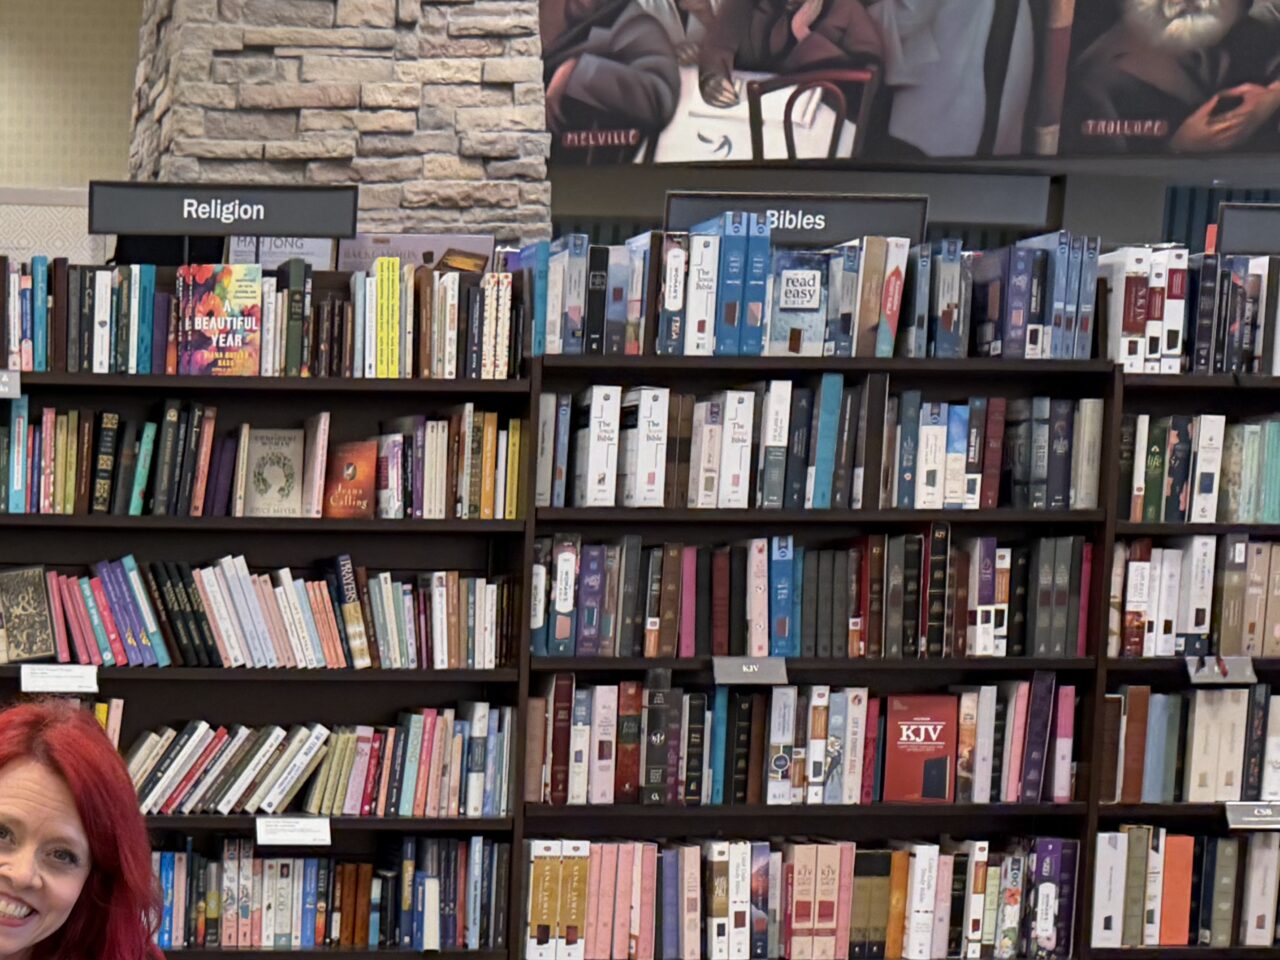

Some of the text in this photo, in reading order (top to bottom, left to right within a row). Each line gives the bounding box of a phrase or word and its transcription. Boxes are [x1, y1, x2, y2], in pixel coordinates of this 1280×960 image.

[565, 129, 639, 147] MELVILLE
[183, 199, 265, 223] Religion
[767, 210, 826, 230] Bibles
[268, 236, 304, 250] JONG
[785, 274, 816, 288] read
[784, 289, 816, 302] easy
[224, 299, 231, 312] A
[194, 317, 259, 330] BEAUTIFUL
[211, 334, 243, 347] YEAR
[337, 484, 363, 495] Jesus
[330, 494, 368, 510] Calling
[340, 557, 356, 604] PRAYERS
[741, 664, 759, 672] KJV
[899, 724, 944, 743] KJV
[1254, 808, 1273, 816] CSB
